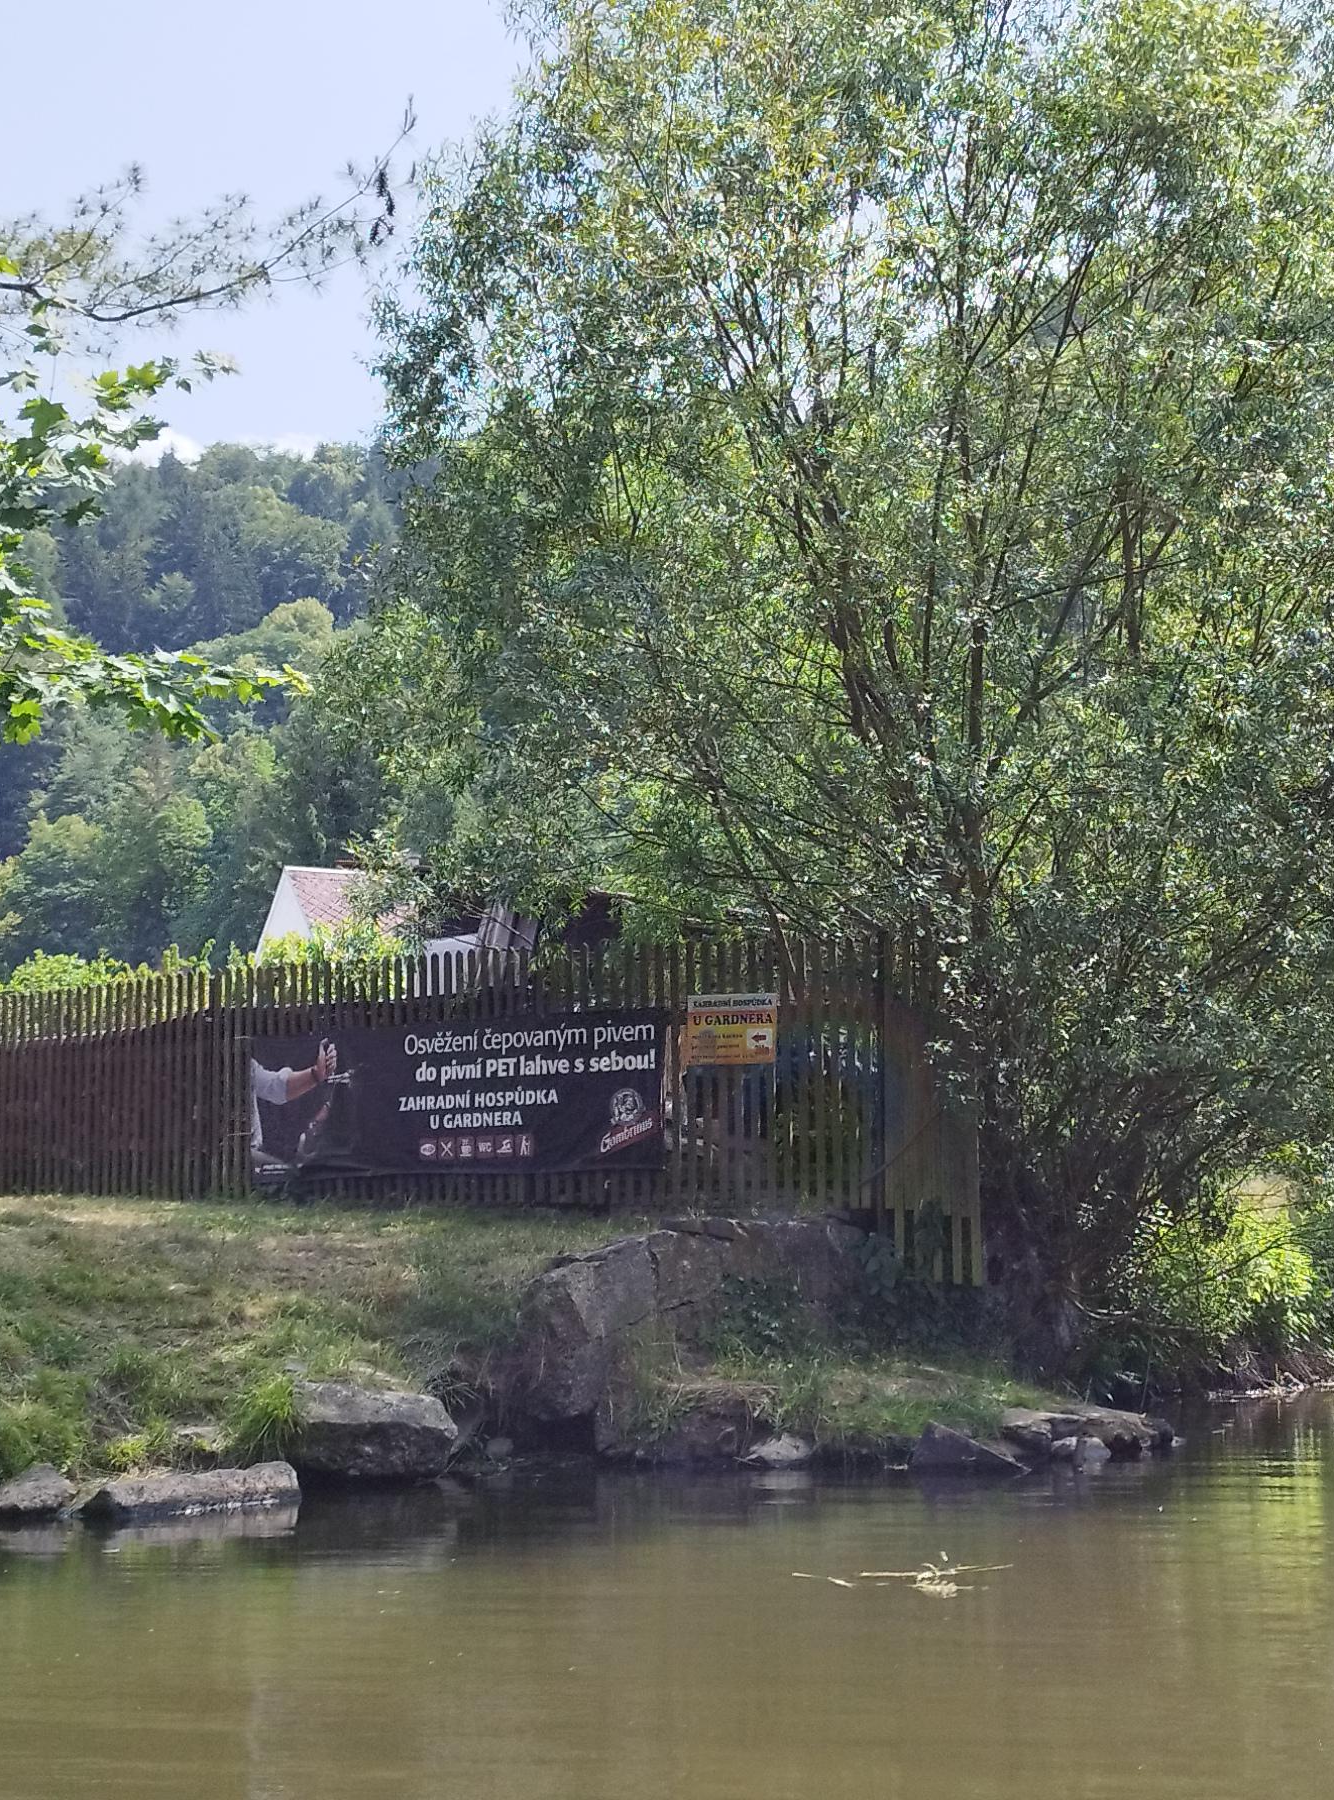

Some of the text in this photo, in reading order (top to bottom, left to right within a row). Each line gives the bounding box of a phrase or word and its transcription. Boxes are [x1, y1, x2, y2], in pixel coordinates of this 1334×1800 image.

[693, 1013, 773, 1026] U GARDNERA
[404, 1020, 655, 1055] Osvěžení čepovaným pivem
[415, 1048, 656, 1087] do pivní PET lahve s sebou!
[398, 1085, 559, 1112] ZAHRADNÍ HOSPŮDKA
[429, 1110, 523, 1130] U GARDNERA
[600, 1117, 653, 1153] Gambrinus
